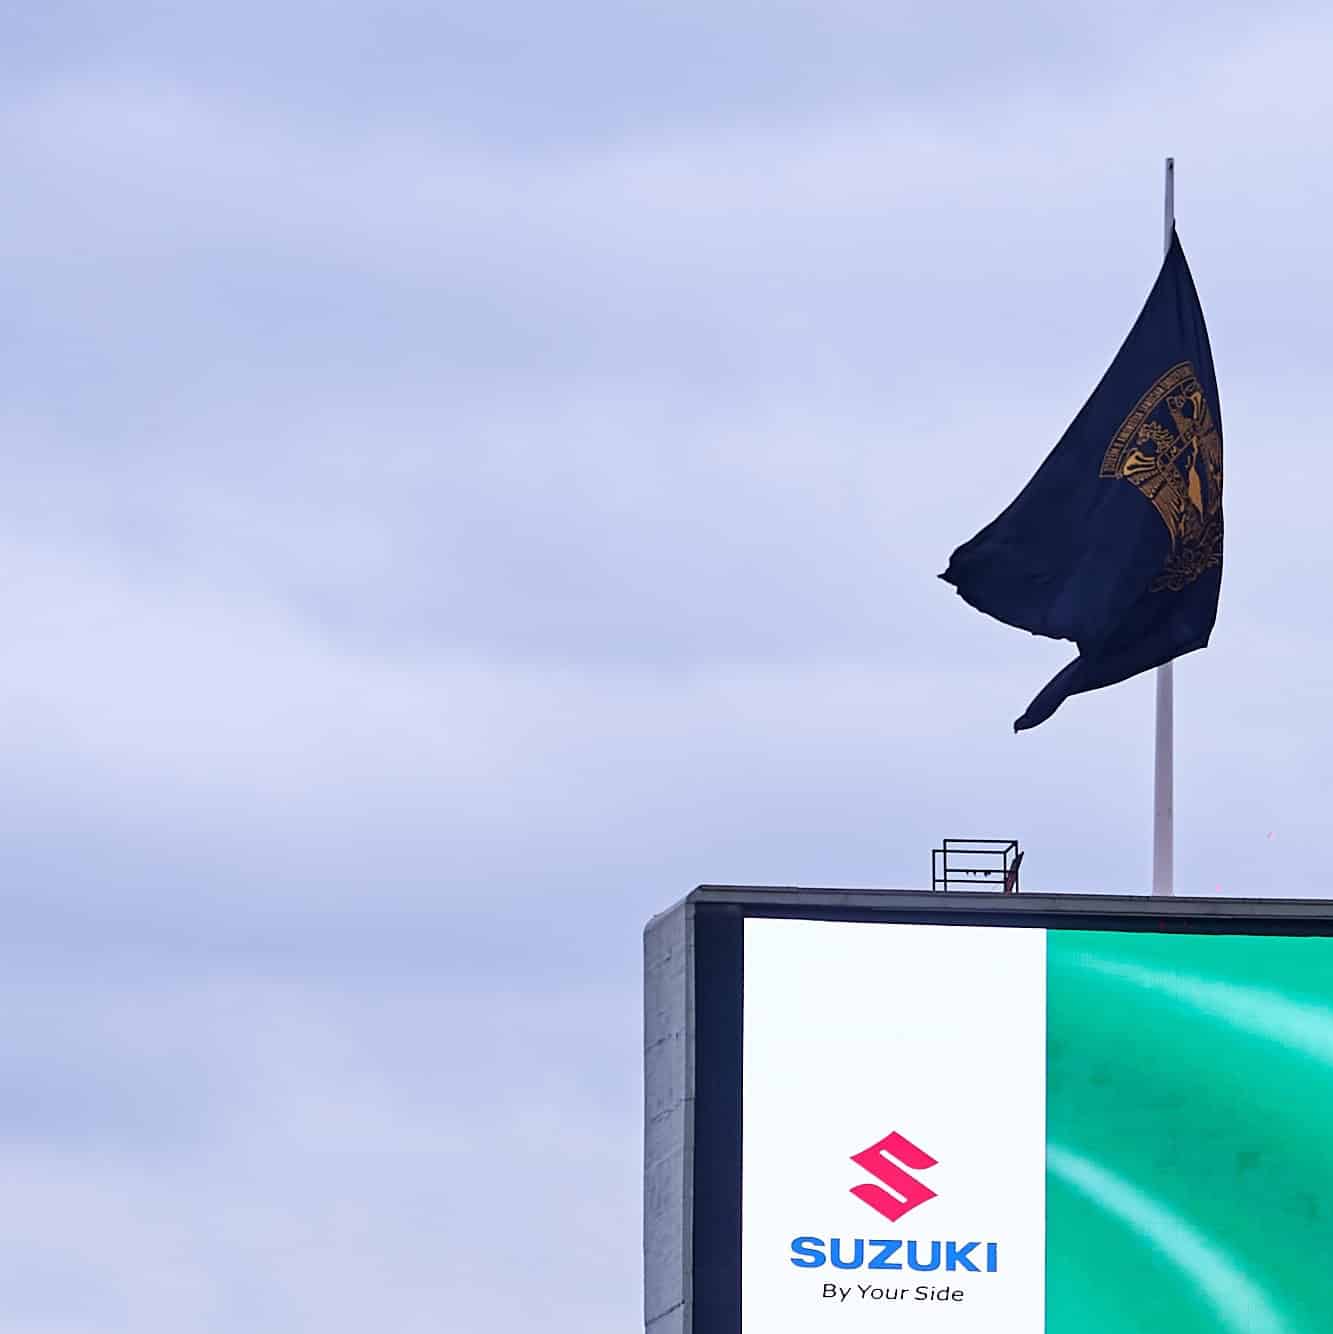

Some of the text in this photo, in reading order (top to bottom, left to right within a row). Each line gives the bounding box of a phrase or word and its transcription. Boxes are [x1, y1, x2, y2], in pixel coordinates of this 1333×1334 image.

[790, 1236, 998, 1272] SUZUKI
[822, 1283, 965, 1302] By Your Side
